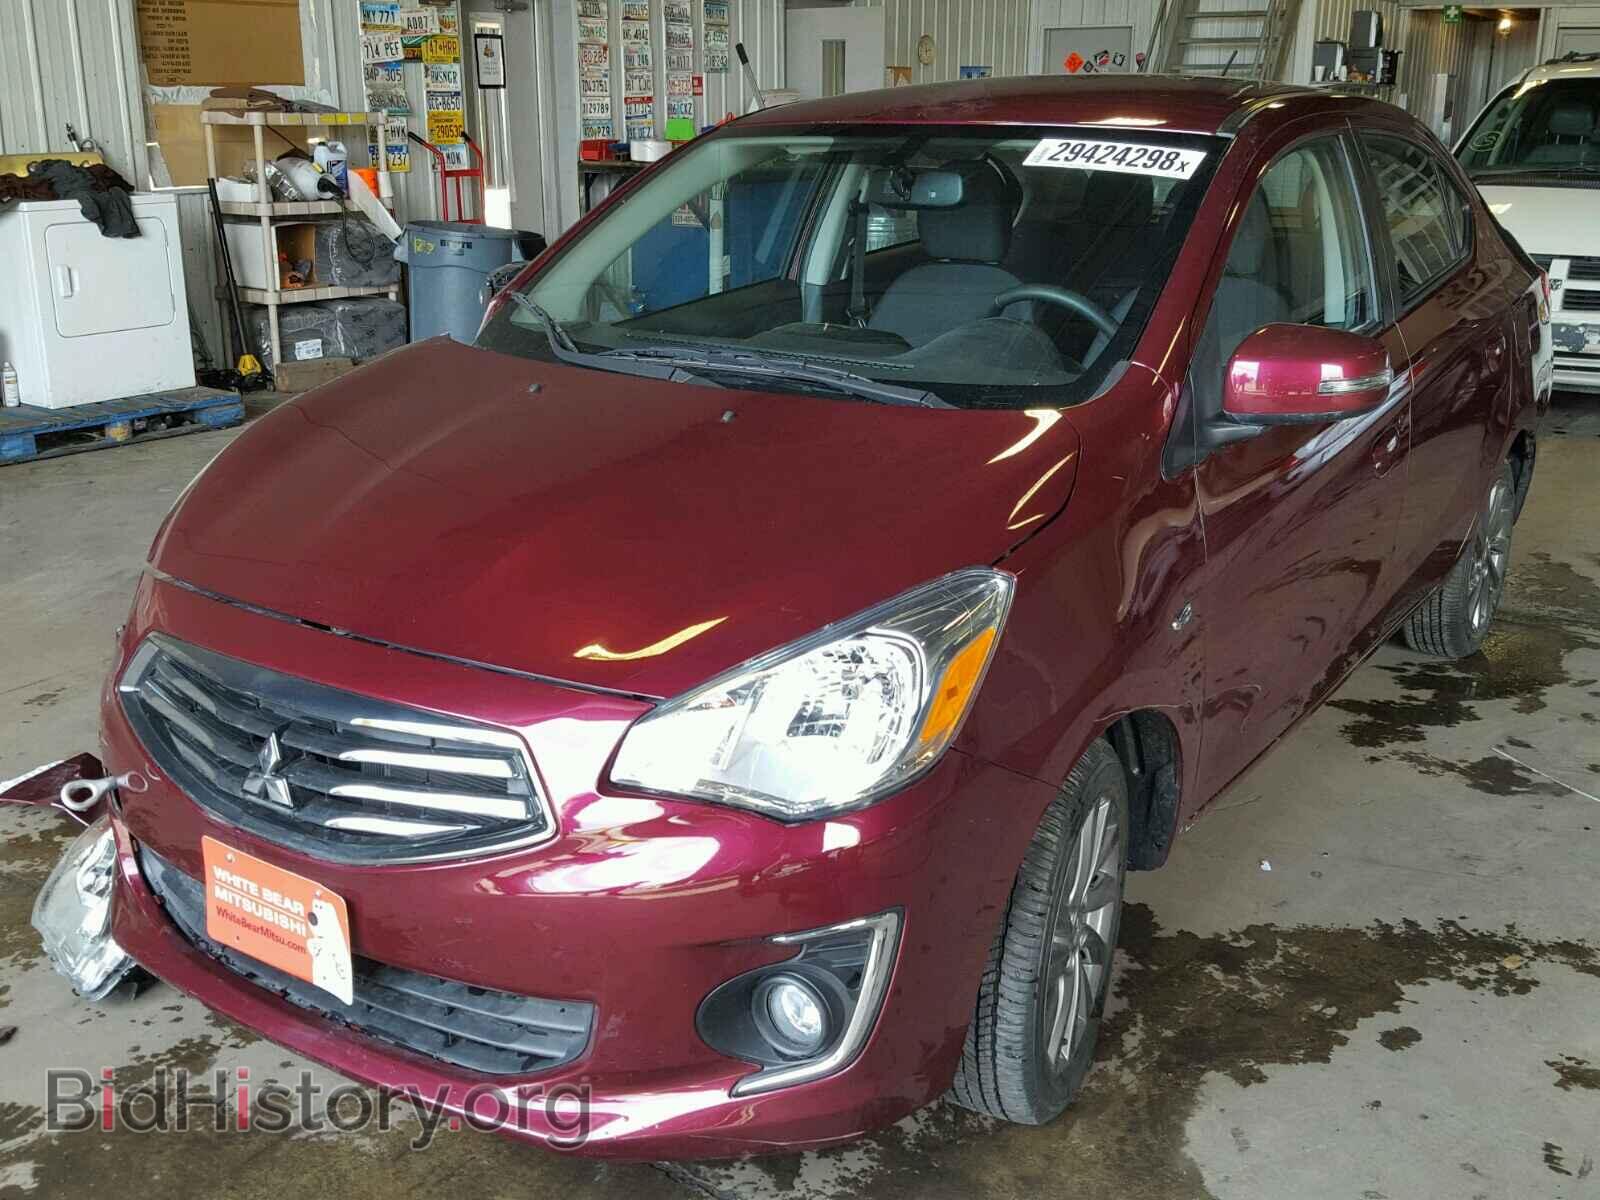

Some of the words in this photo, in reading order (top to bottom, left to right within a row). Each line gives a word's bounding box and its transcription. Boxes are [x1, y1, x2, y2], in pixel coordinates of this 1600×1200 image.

[384, 68, 402, 82] 305
[392, 153, 407, 166] 237
[213, 865, 259, 897] WHITE
[262, 887, 305, 916] BEAR
[214, 885, 306, 937] MITSUBISHI
[216, 906, 306, 954] WhiteBearMitsu.com
